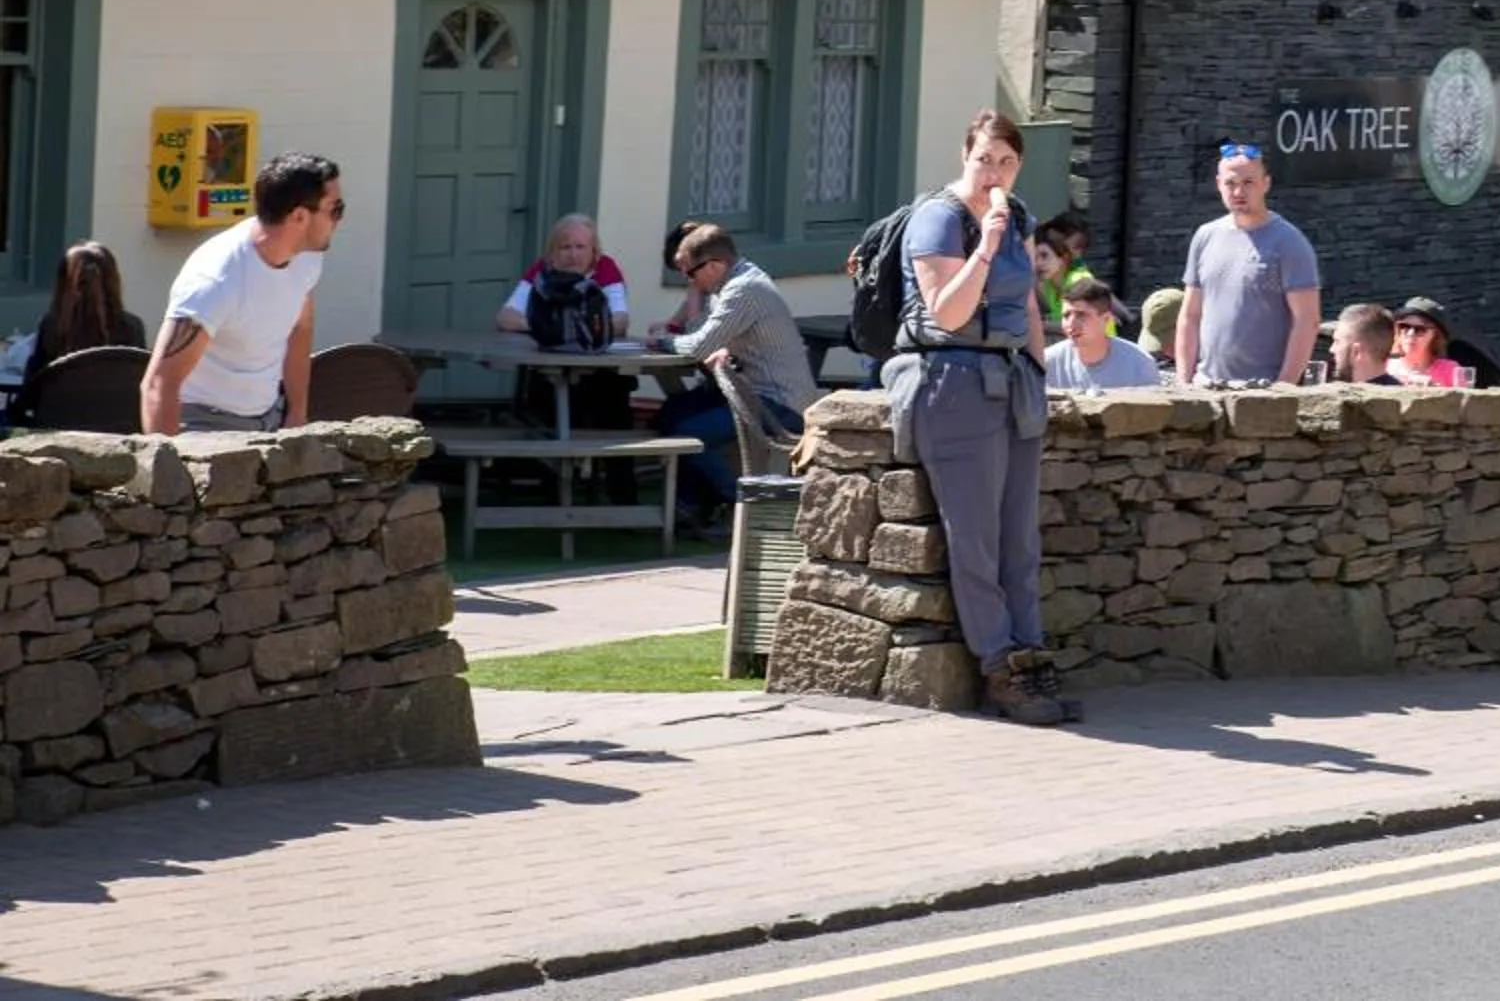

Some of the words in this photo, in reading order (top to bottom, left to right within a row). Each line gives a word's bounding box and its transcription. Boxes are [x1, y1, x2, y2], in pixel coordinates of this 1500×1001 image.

[155, 131, 188, 149] AED
[1276, 108, 1339, 154] OAK
[1344, 106, 1412, 151] TREE
